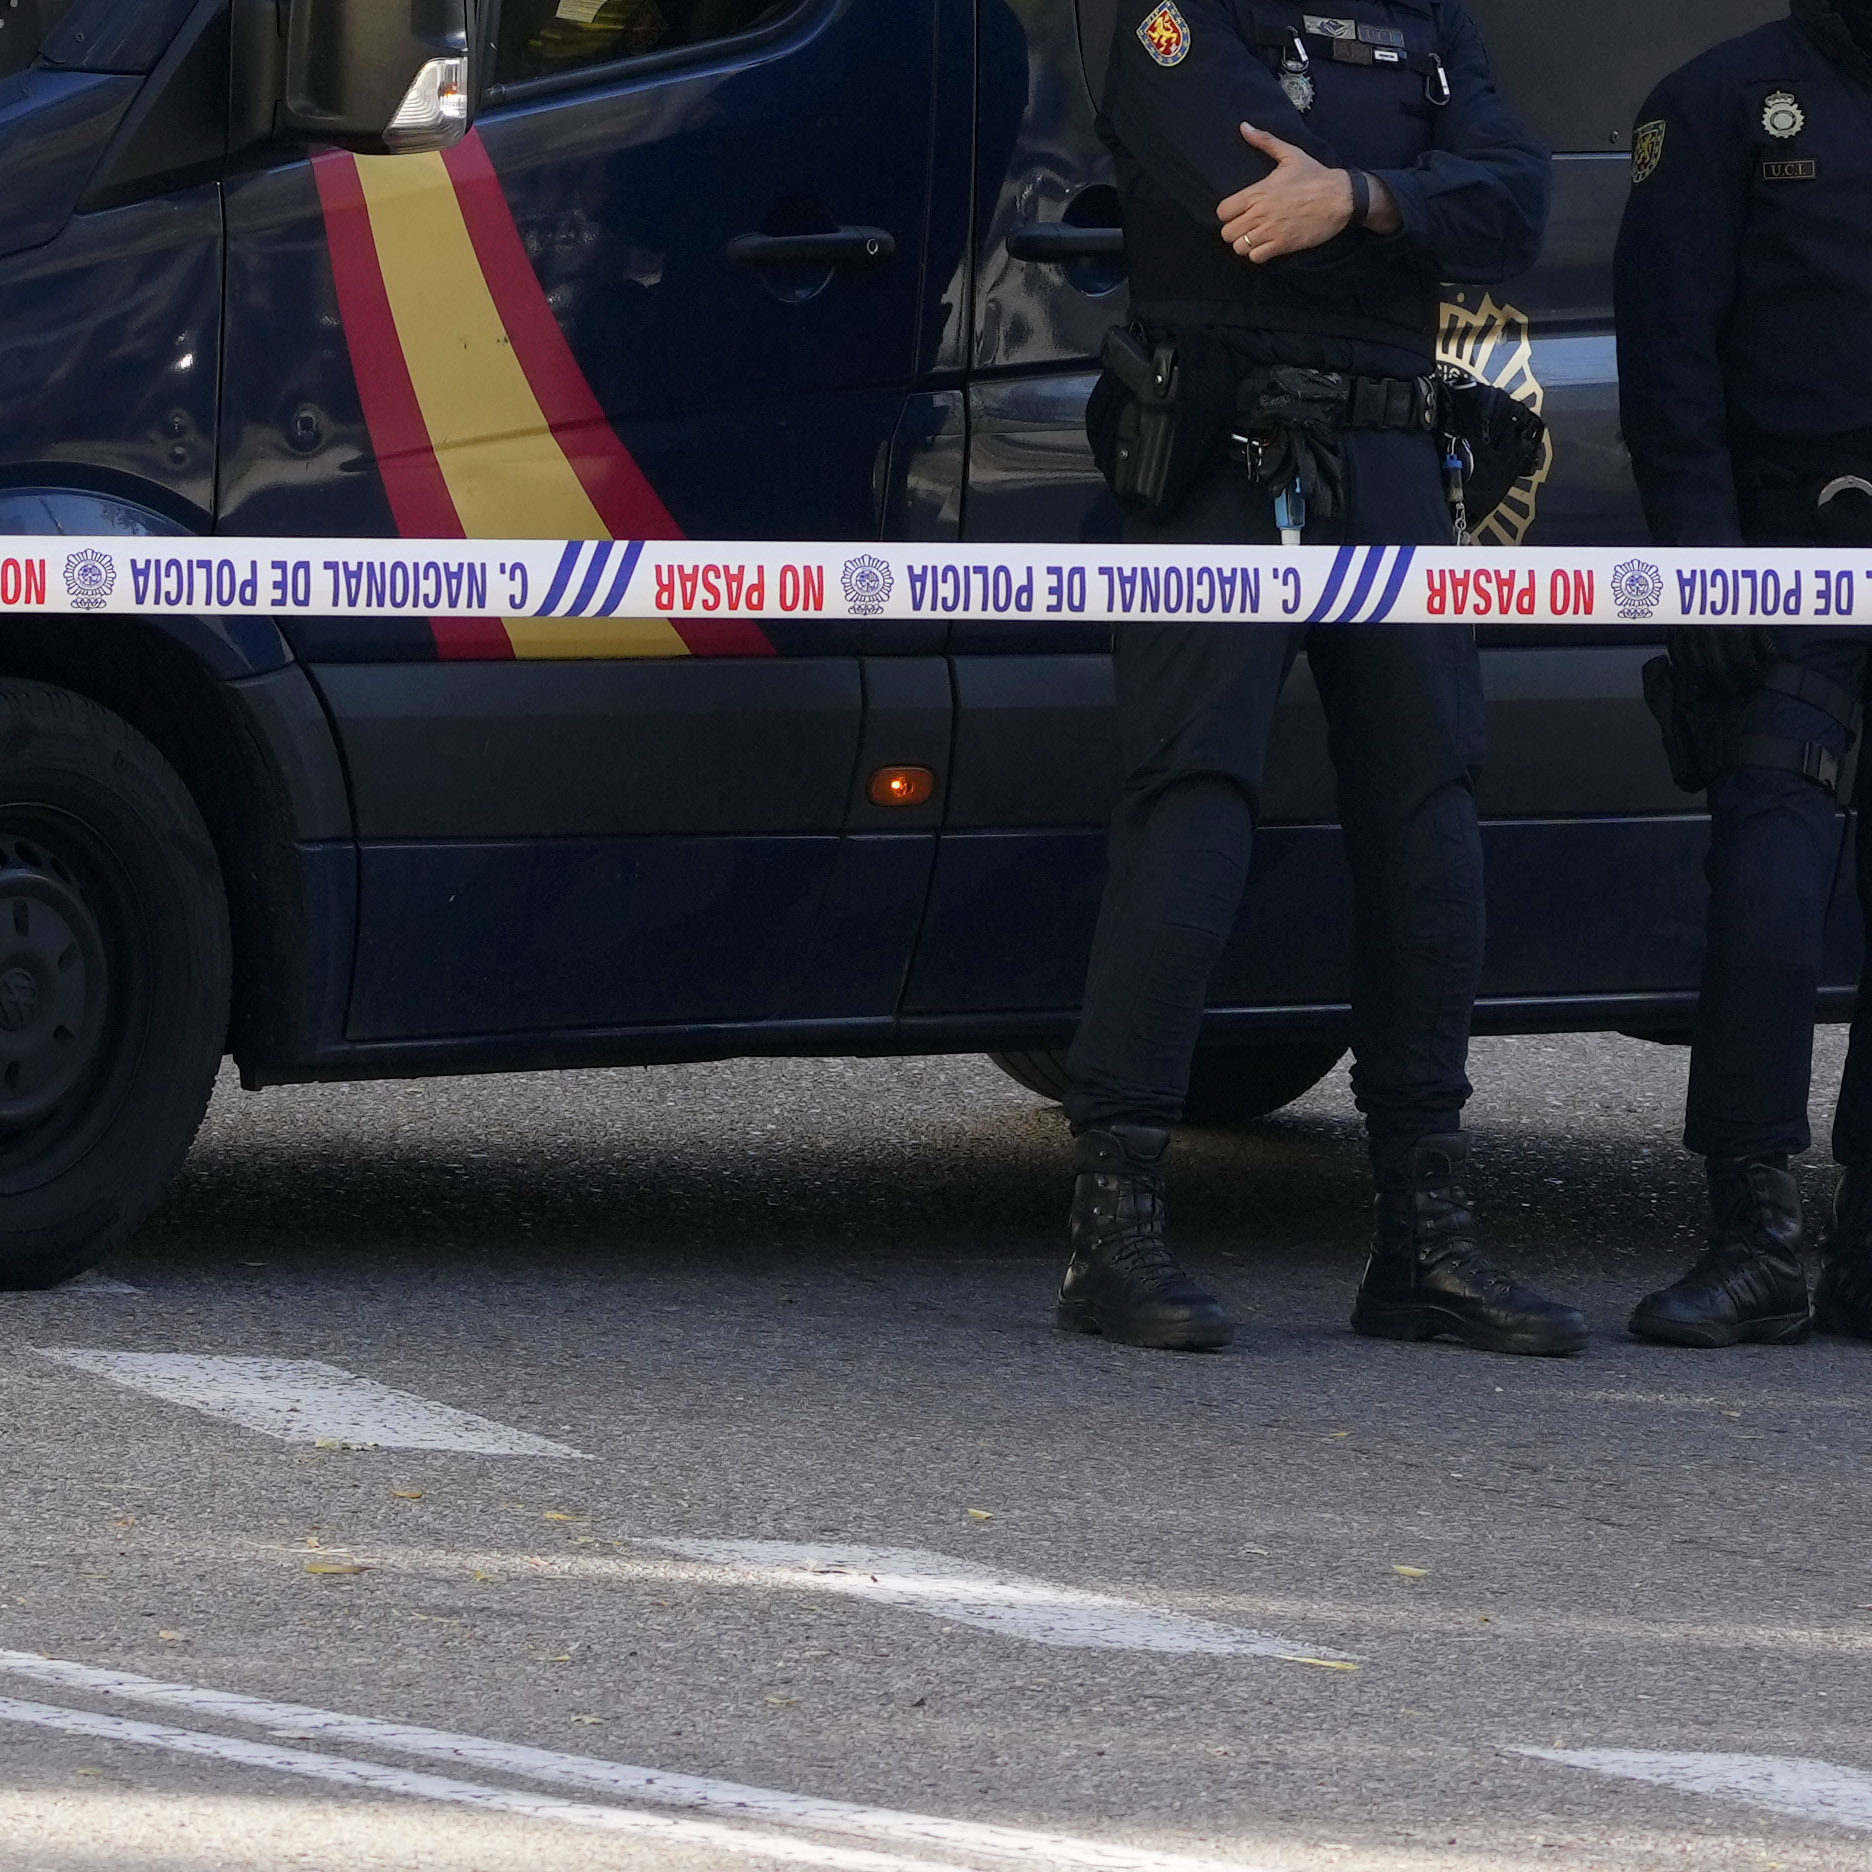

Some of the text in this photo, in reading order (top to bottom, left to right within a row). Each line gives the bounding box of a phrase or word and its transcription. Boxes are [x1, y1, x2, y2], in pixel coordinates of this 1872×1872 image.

[1771, 163, 1807, 176] U.C.I.
[0, 558, 47, 605] NO
[131, 558, 529, 608] C. NACIONAL DE POLICIA
[655, 564, 825, 612] NO PASAR
[907, 564, 1302, 613] C. NACIONAL DE POLICIA
[1427, 569, 1595, 616] NO PASAR
[1676, 568, 1802, 615] POLICIA
[1814, 568, 1854, 615] DE
